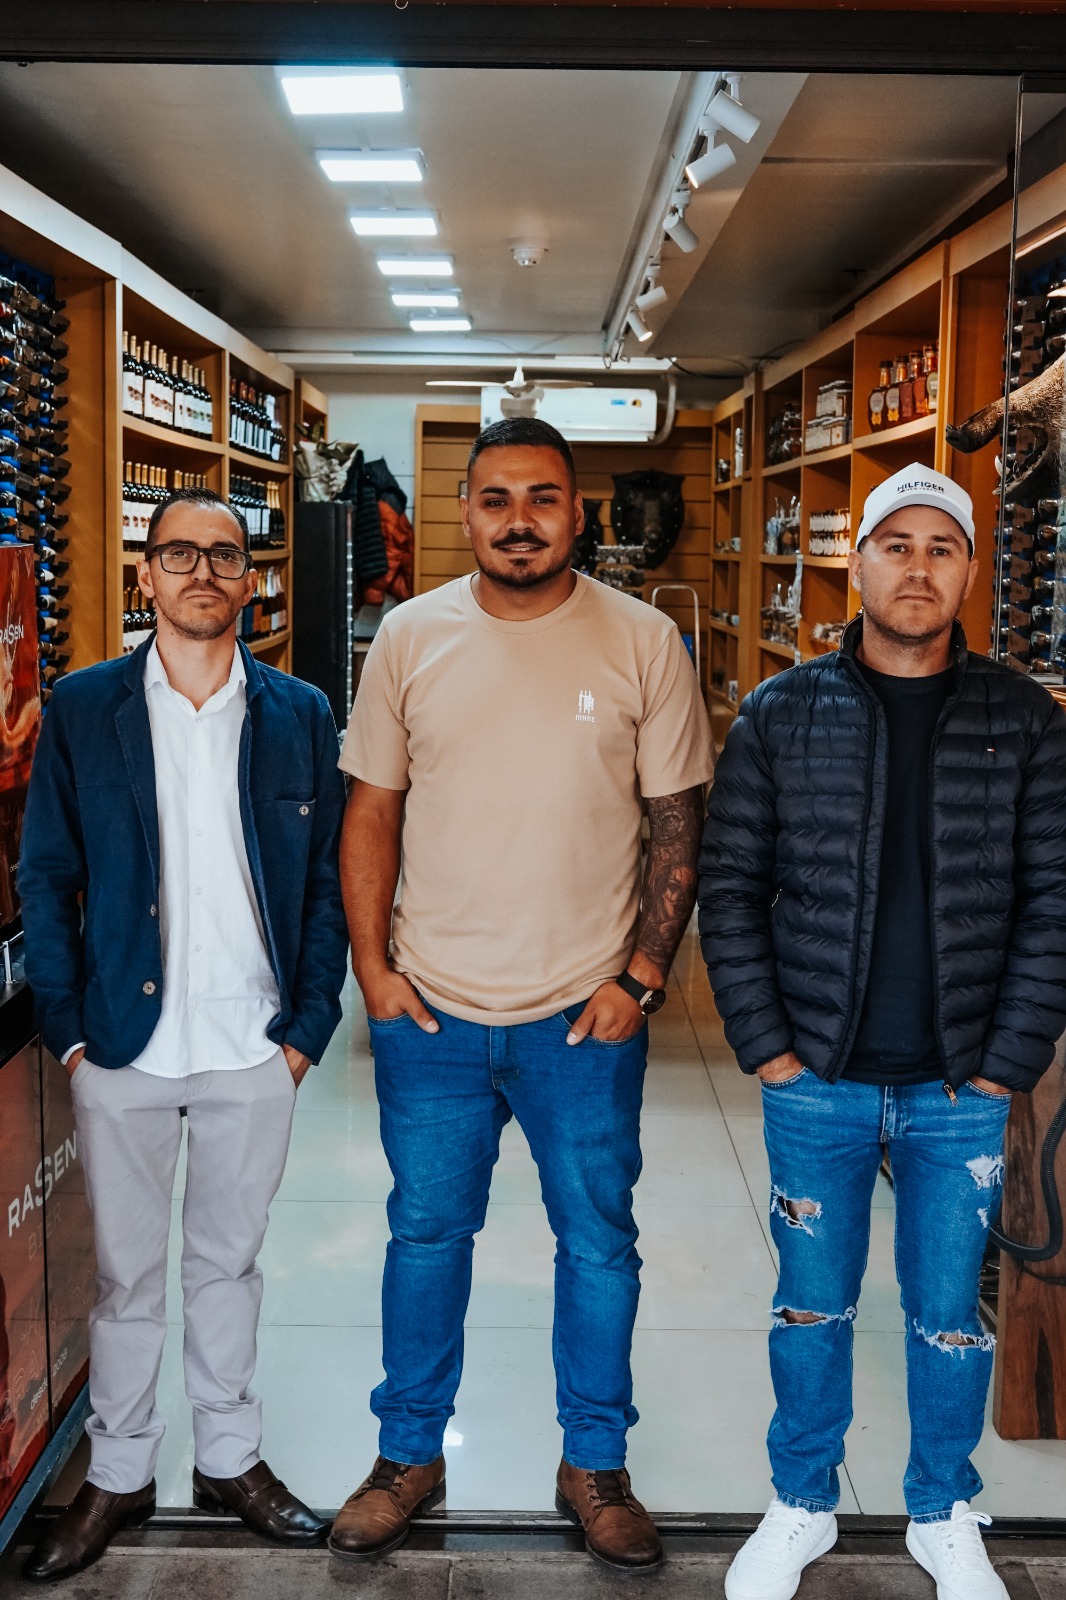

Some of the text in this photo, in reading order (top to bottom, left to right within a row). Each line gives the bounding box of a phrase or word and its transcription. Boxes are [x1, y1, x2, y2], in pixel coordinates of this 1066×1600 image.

[897, 481, 945, 492] HILFIGER
[8, 1130, 77, 1238] RASEN
[28, 1202, 62, 1261] BIER
